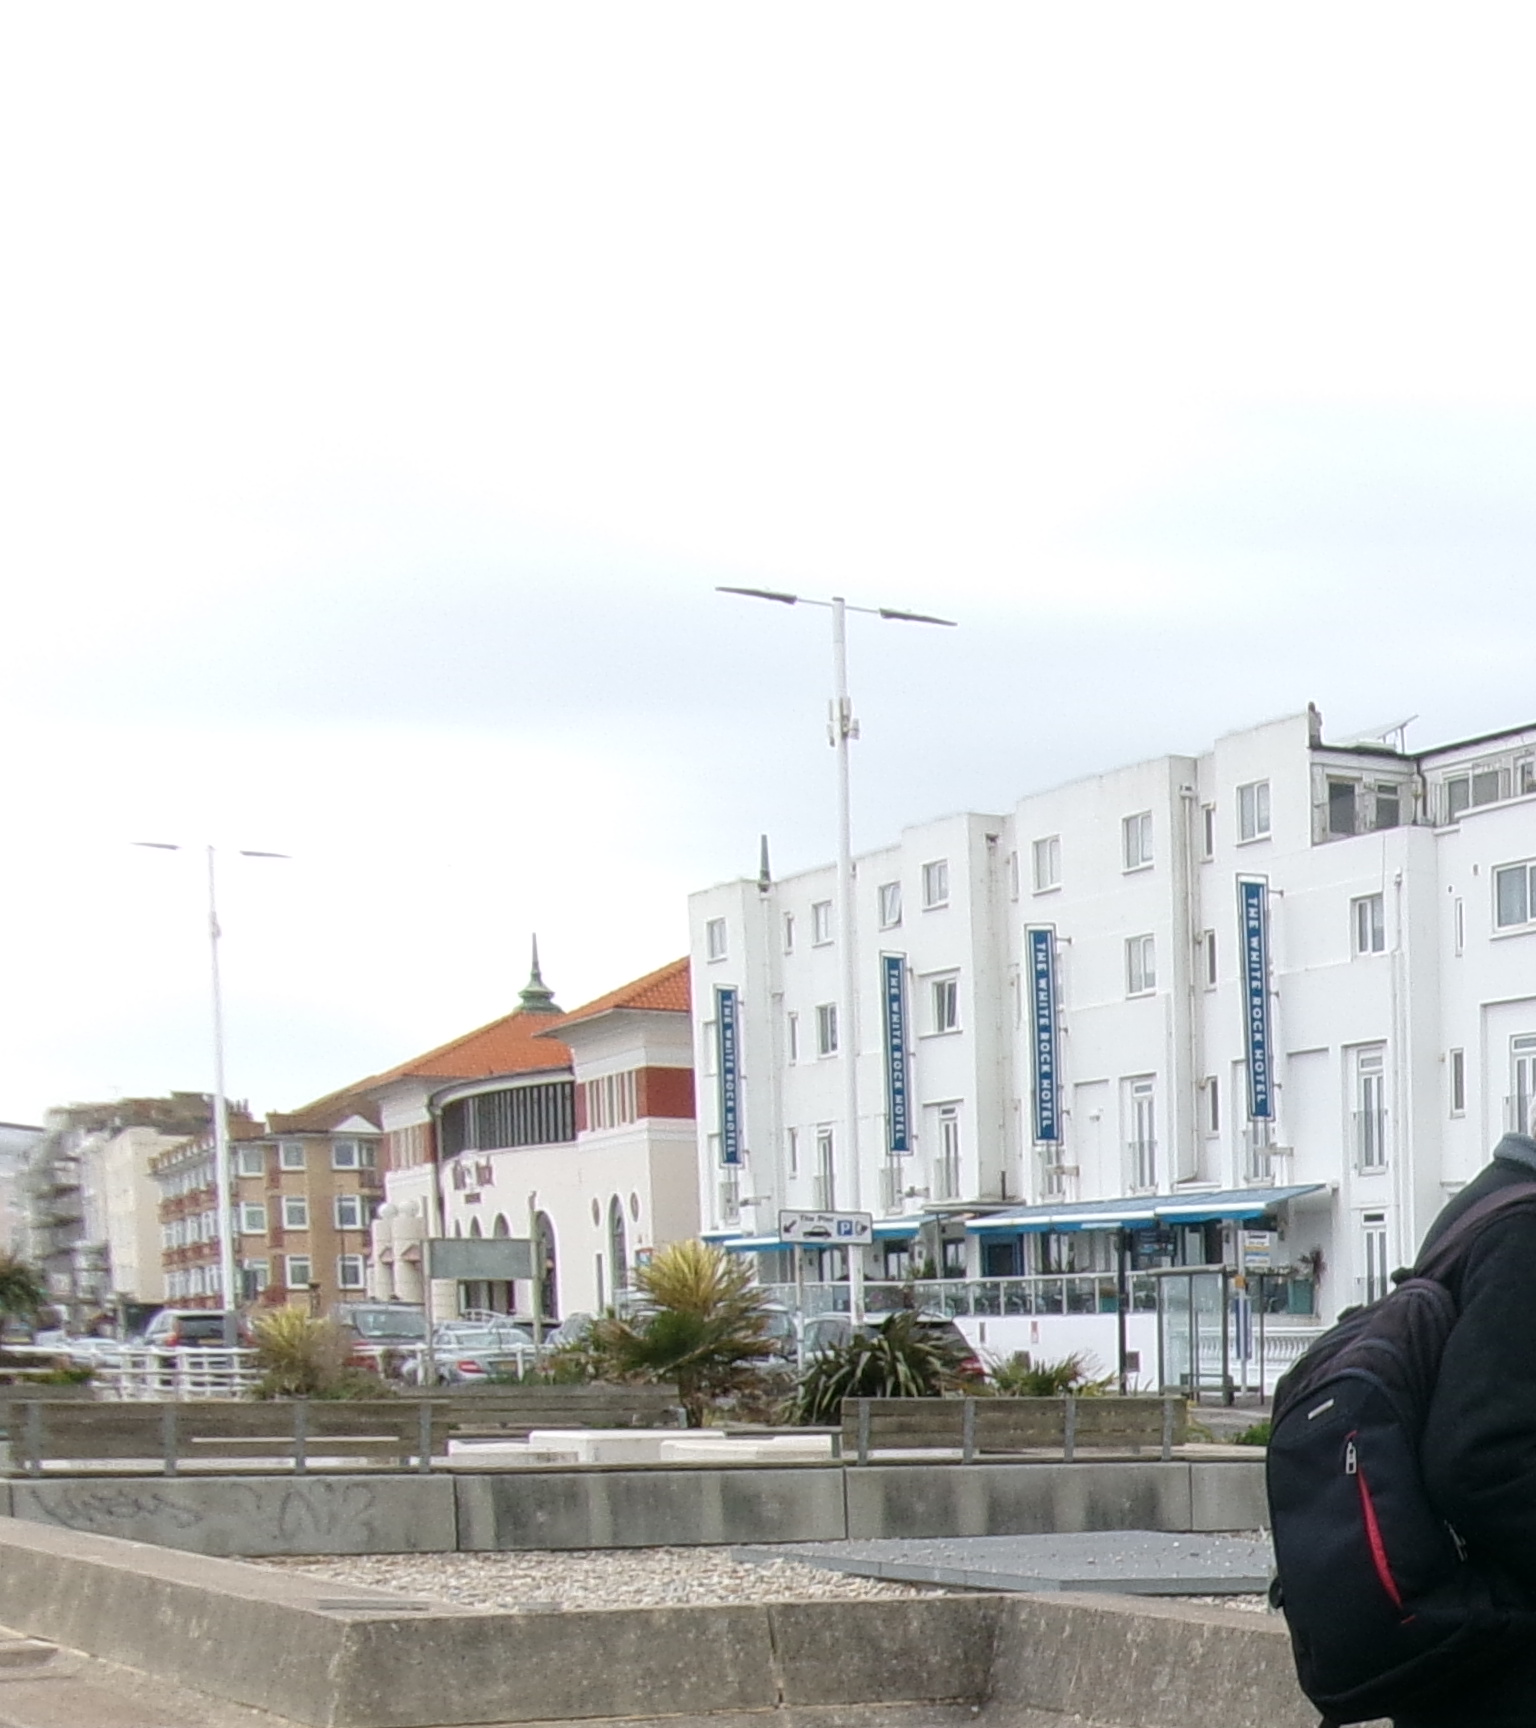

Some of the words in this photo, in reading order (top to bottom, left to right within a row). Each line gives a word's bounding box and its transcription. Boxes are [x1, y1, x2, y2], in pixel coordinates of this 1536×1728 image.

[1247, 896, 1259, 929] THE
[1035, 942, 1047, 971] THE
[1249, 935, 1262, 989] WHITE
[889, 969, 899, 995] THE
[1037, 978, 1049, 1026] WHITE
[891, 1001, 902, 1046] WHITE
[1251, 996, 1263, 1042] ROCK
[893, 1051, 903, 1088] ROCK
[1039, 1031, 1051, 1073] ROCK
[1253, 1049, 1266, 1102] HOTEL
[894, 1094, 905, 1139] HOTEL
[1041, 1080, 1052, 1128] HOTEL
